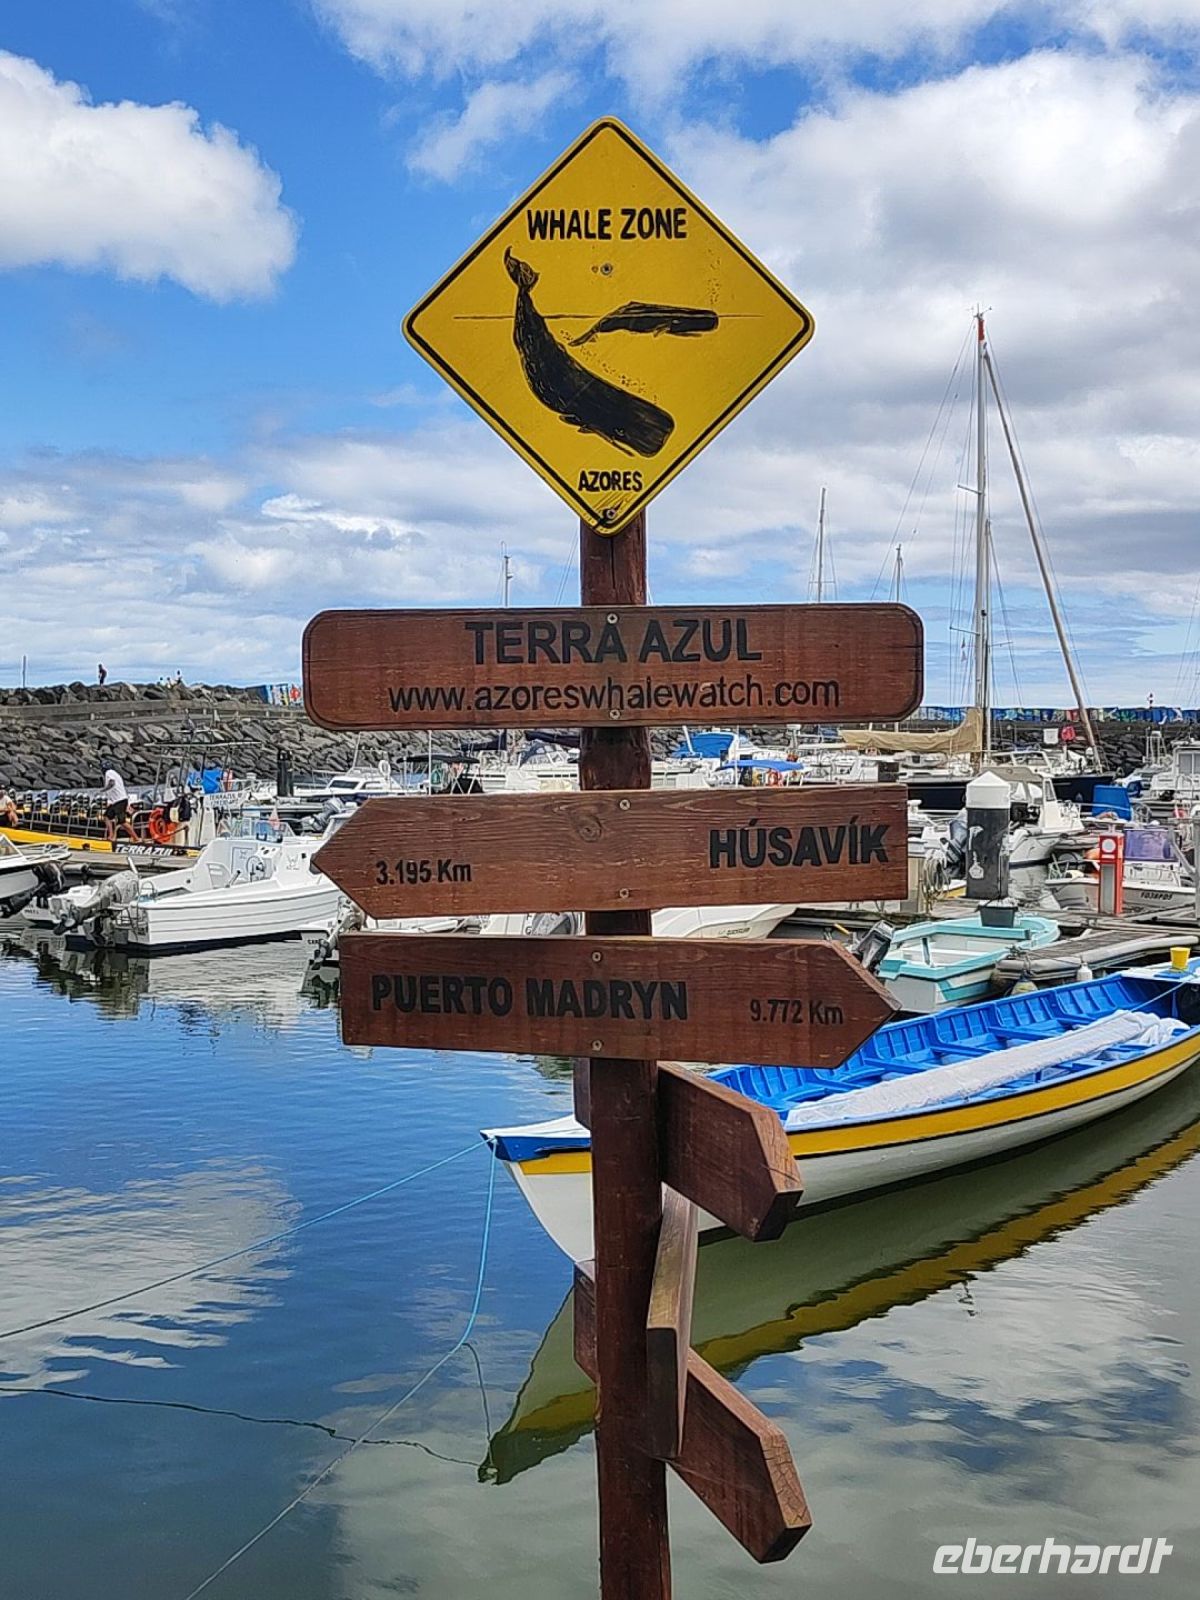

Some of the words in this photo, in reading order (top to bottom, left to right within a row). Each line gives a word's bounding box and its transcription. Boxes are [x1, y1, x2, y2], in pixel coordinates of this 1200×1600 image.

[527, 208, 611, 240] WHALE
[620, 208, 687, 239] ZONE
[578, 471, 643, 491] AZORES
[465, 618, 627, 665] TERRA
[638, 618, 763, 662] AZUL
[389, 675, 840, 712] www.azoreswhalewatch.com
[708, 816, 890, 869] HÚSAVÍK
[375, 862, 433, 886] 3.195
[438, 858, 472, 883] Km
[371, 974, 513, 1016] PUERTO
[525, 978, 689, 1021] MADRYN
[749, 999, 803, 1024] 9.772
[809, 1002, 844, 1025] Km
